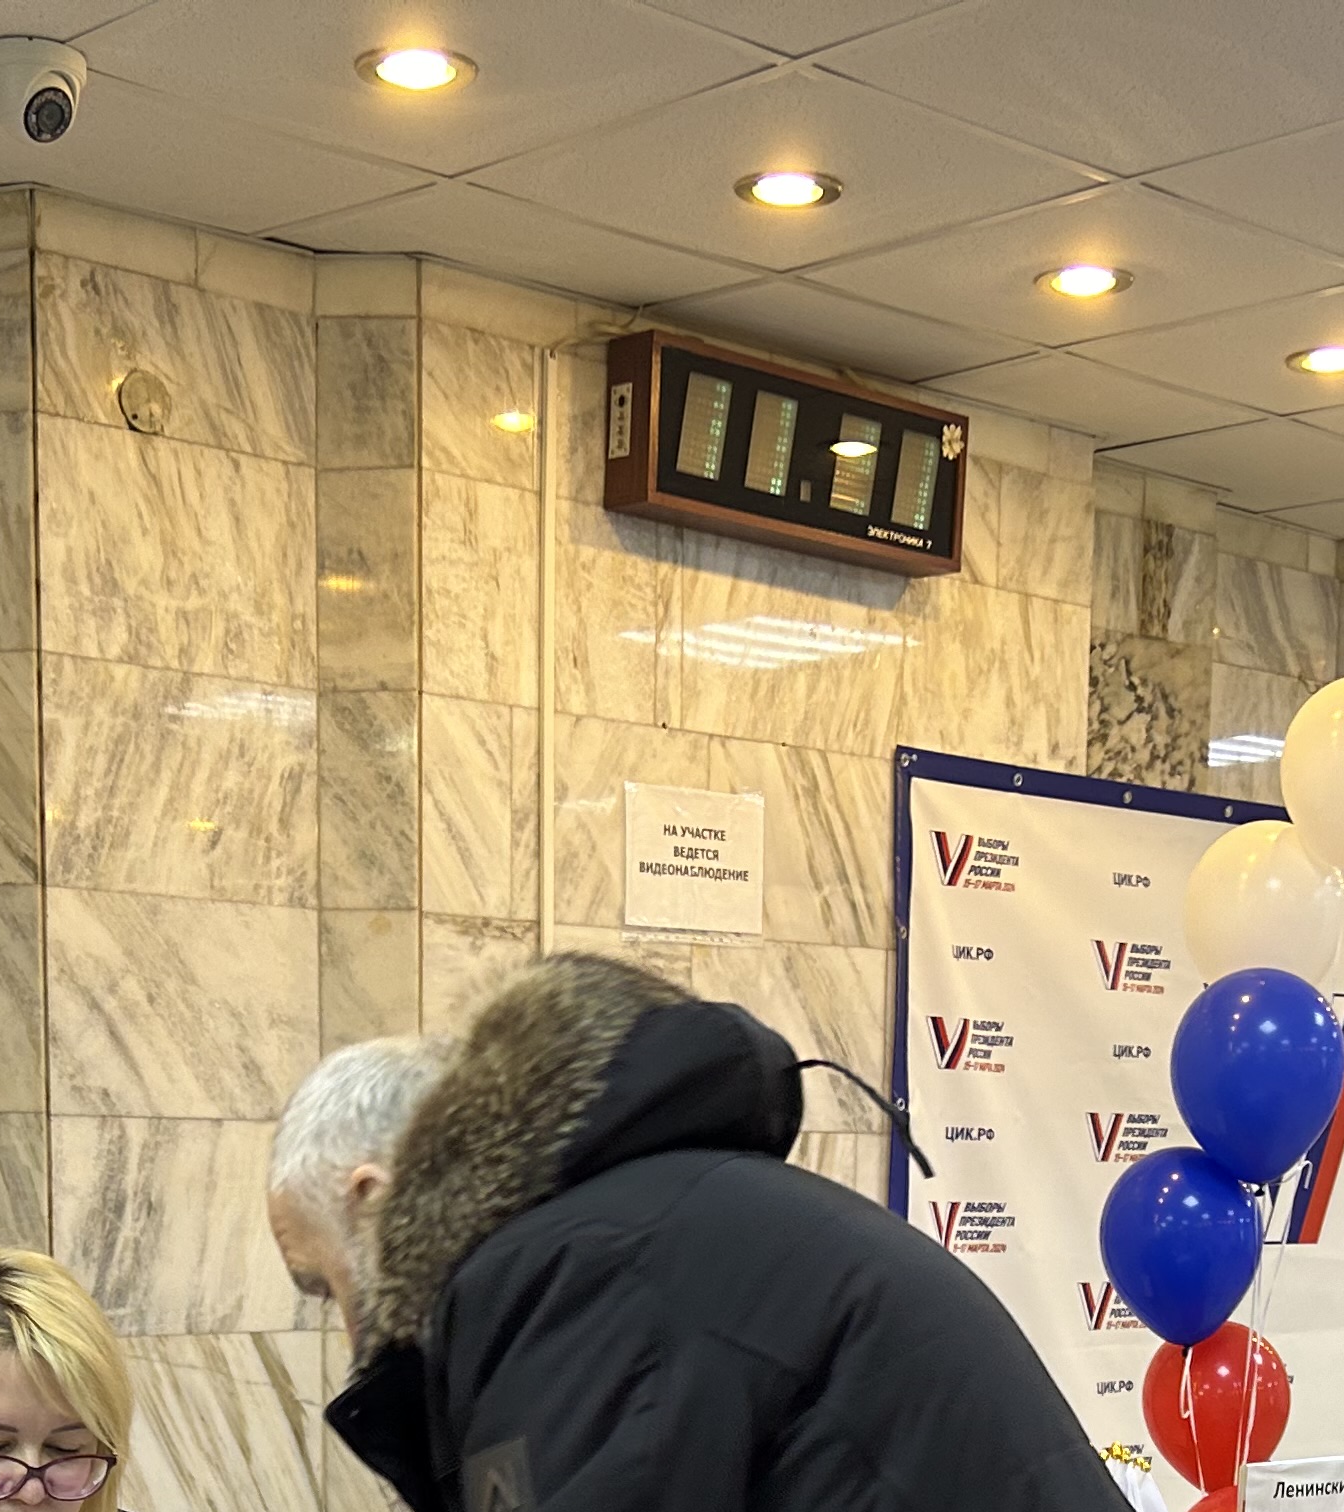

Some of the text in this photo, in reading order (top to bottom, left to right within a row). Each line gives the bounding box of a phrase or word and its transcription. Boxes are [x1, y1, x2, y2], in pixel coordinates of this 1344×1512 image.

[664, 824, 726, 842] НА УЧАСТКЕ
[673, 846, 719, 861] ВЕДЕТСЯ
[639, 861, 749, 882] ВИДЕОНАБЛЮДЕНИЕ
[1113, 872, 1151, 888] ЦИК.РФ
[952, 944, 994, 961] ЦИК.РФ
[1113, 1044, 1151, 1060] ЦИК.РФ
[945, 1126, 995, 1143] ЦИК.РФ
[1096, 1380, 1134, 1396] ЦИК.РФ
